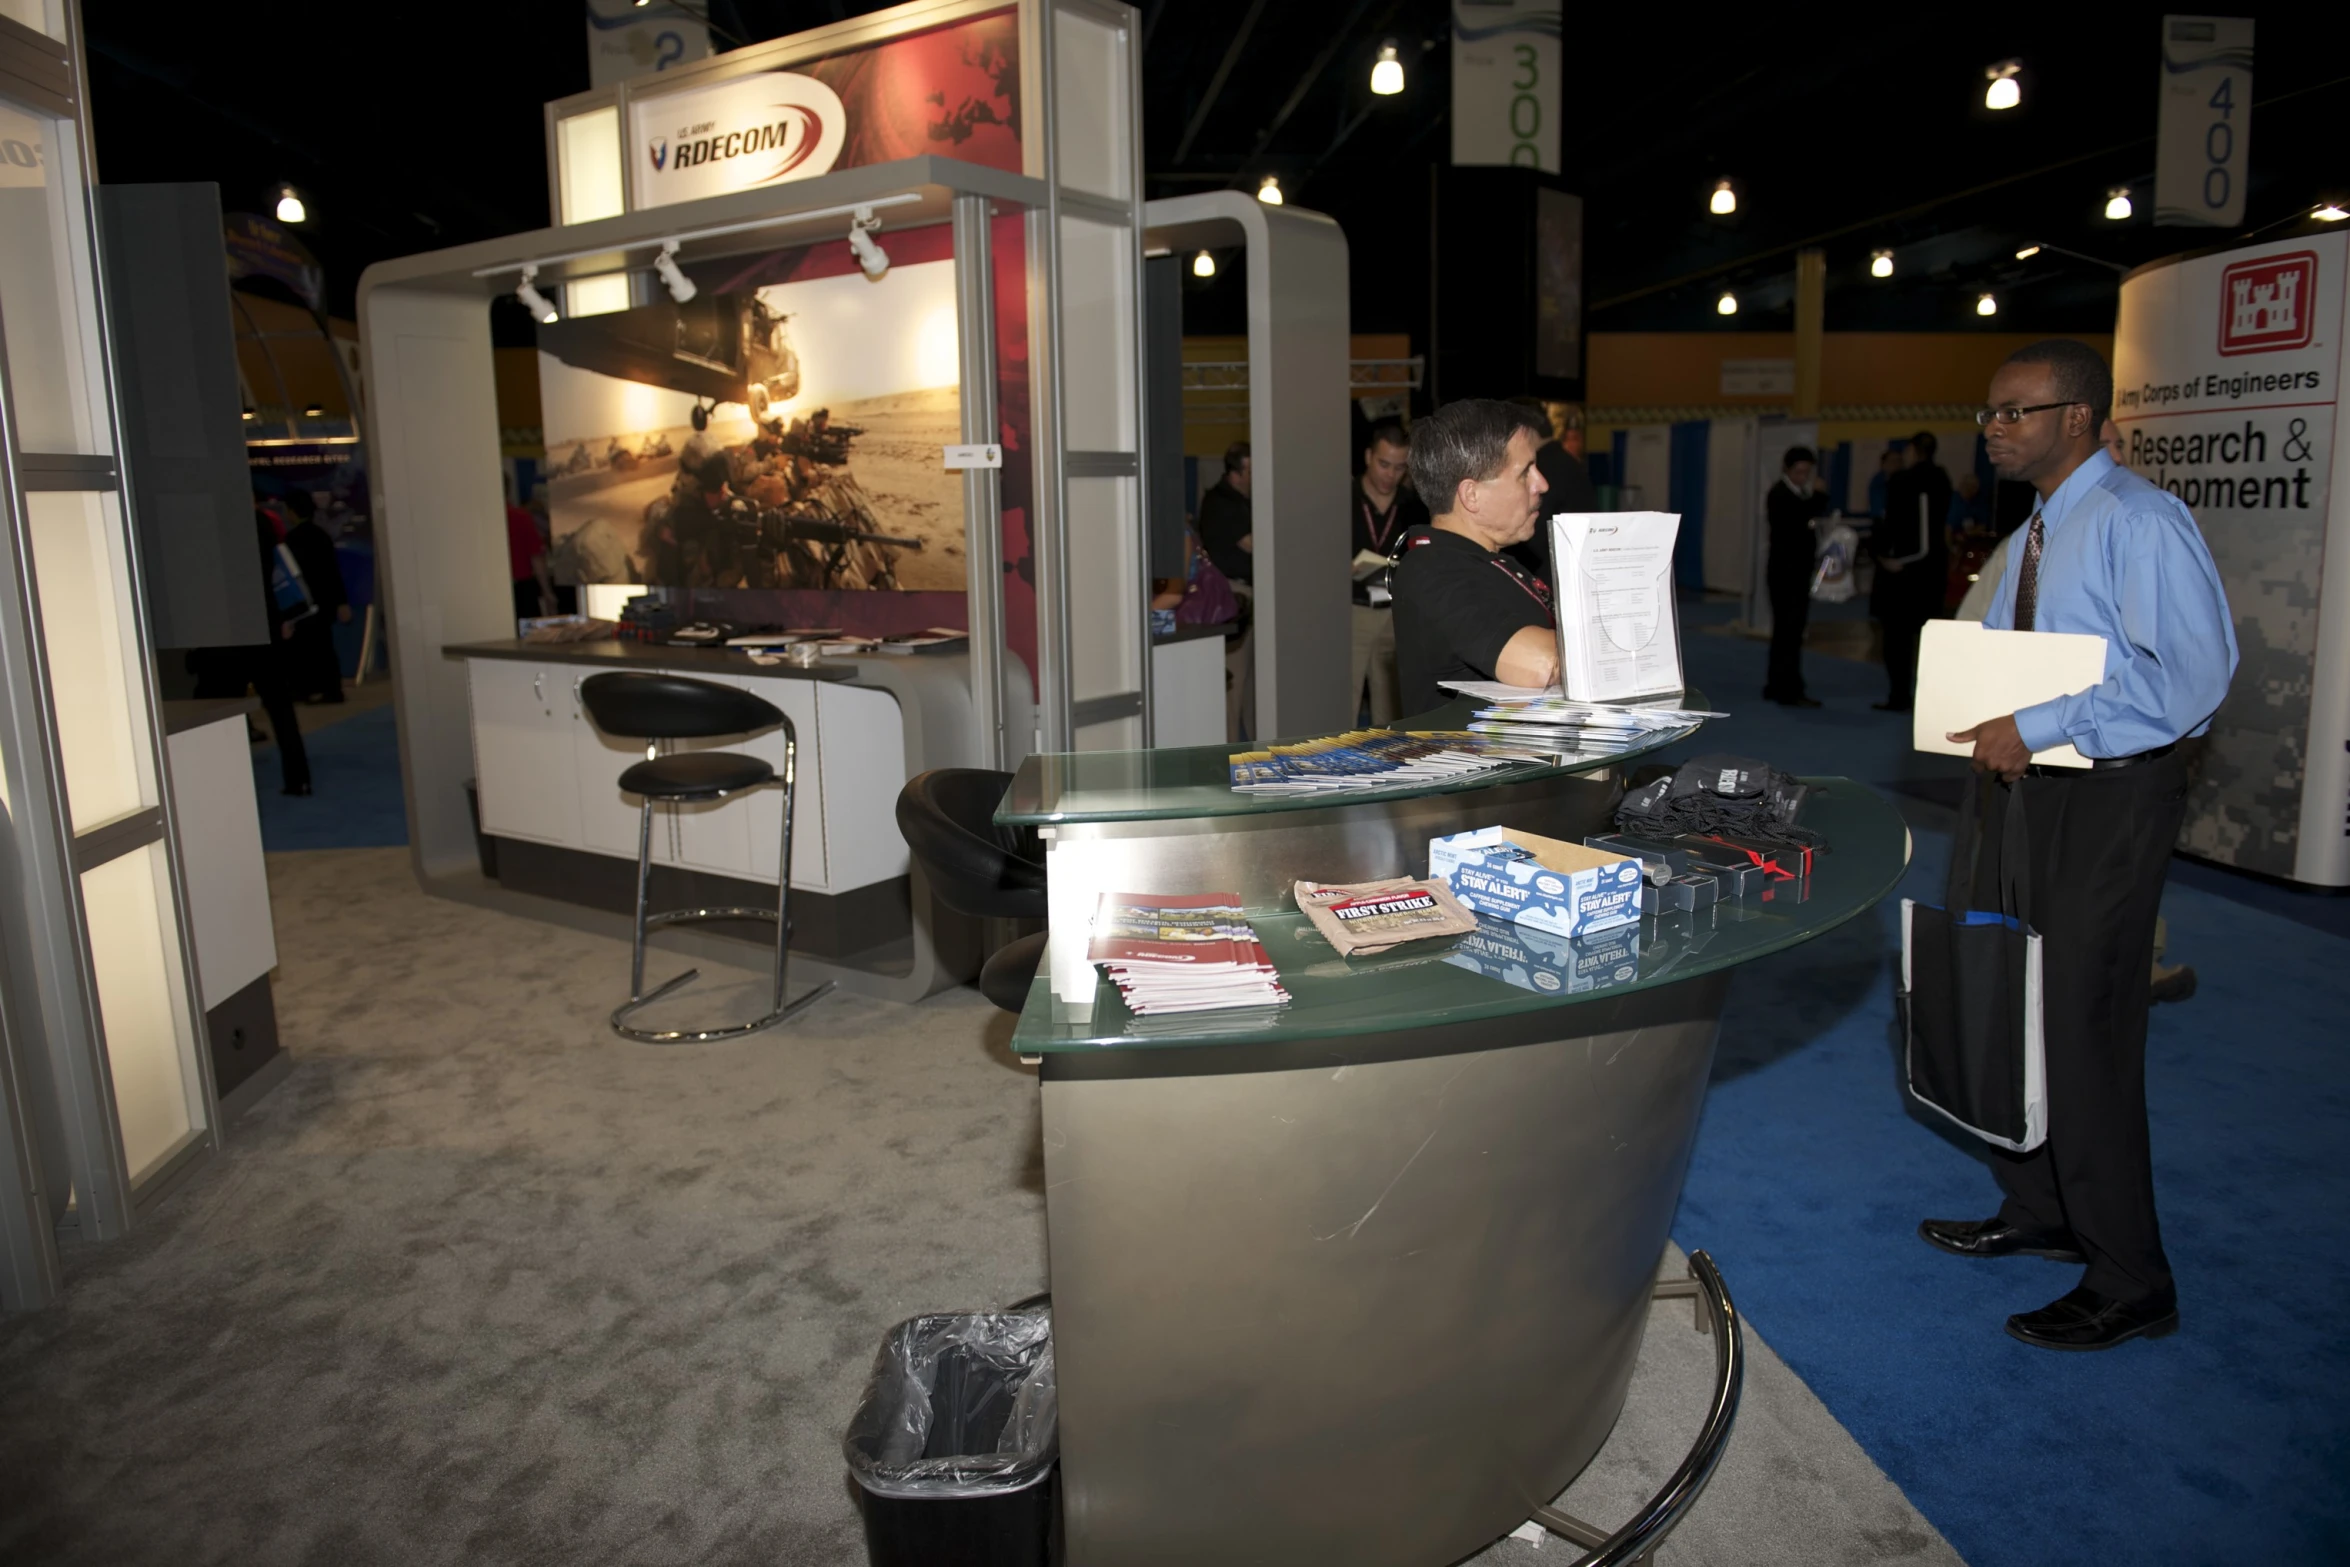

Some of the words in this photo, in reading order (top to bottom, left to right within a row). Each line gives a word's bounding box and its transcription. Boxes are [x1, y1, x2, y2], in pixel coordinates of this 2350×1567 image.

[691, 121, 716, 135] ARMY
[673, 121, 788, 170] RDECOM
[2203, 77, 2235, 209] 400
[2121, 390, 2140, 409] Army
[2142, 383, 2179, 405] Corps
[2183, 376, 2201, 398] of
[2206, 370, 2320, 399] Engineers
[2131, 420, 2266, 467] Research
[2283, 418, 2313, 462] &
[2149, 468, 2312, 509] lopment
[1461, 868, 1474, 876] STAY
[1391, 893, 1410, 901] FLAVOR
[1461, 875, 1488, 892] STAY
[1488, 882, 1530, 901] ALERT
[1334, 904, 1379, 919] FIRST
[1379, 896, 1434, 915] STRIKE
[1470, 892, 1492, 902] CAFFEINE
[1492, 896, 1521, 910] SUPPLEMENT
[1479, 900, 1500, 910] CHEWING
[1500, 904, 1511, 912] GUM
[1580, 899, 1601, 913] STAY
[1601, 892, 1631, 908] ALERT
